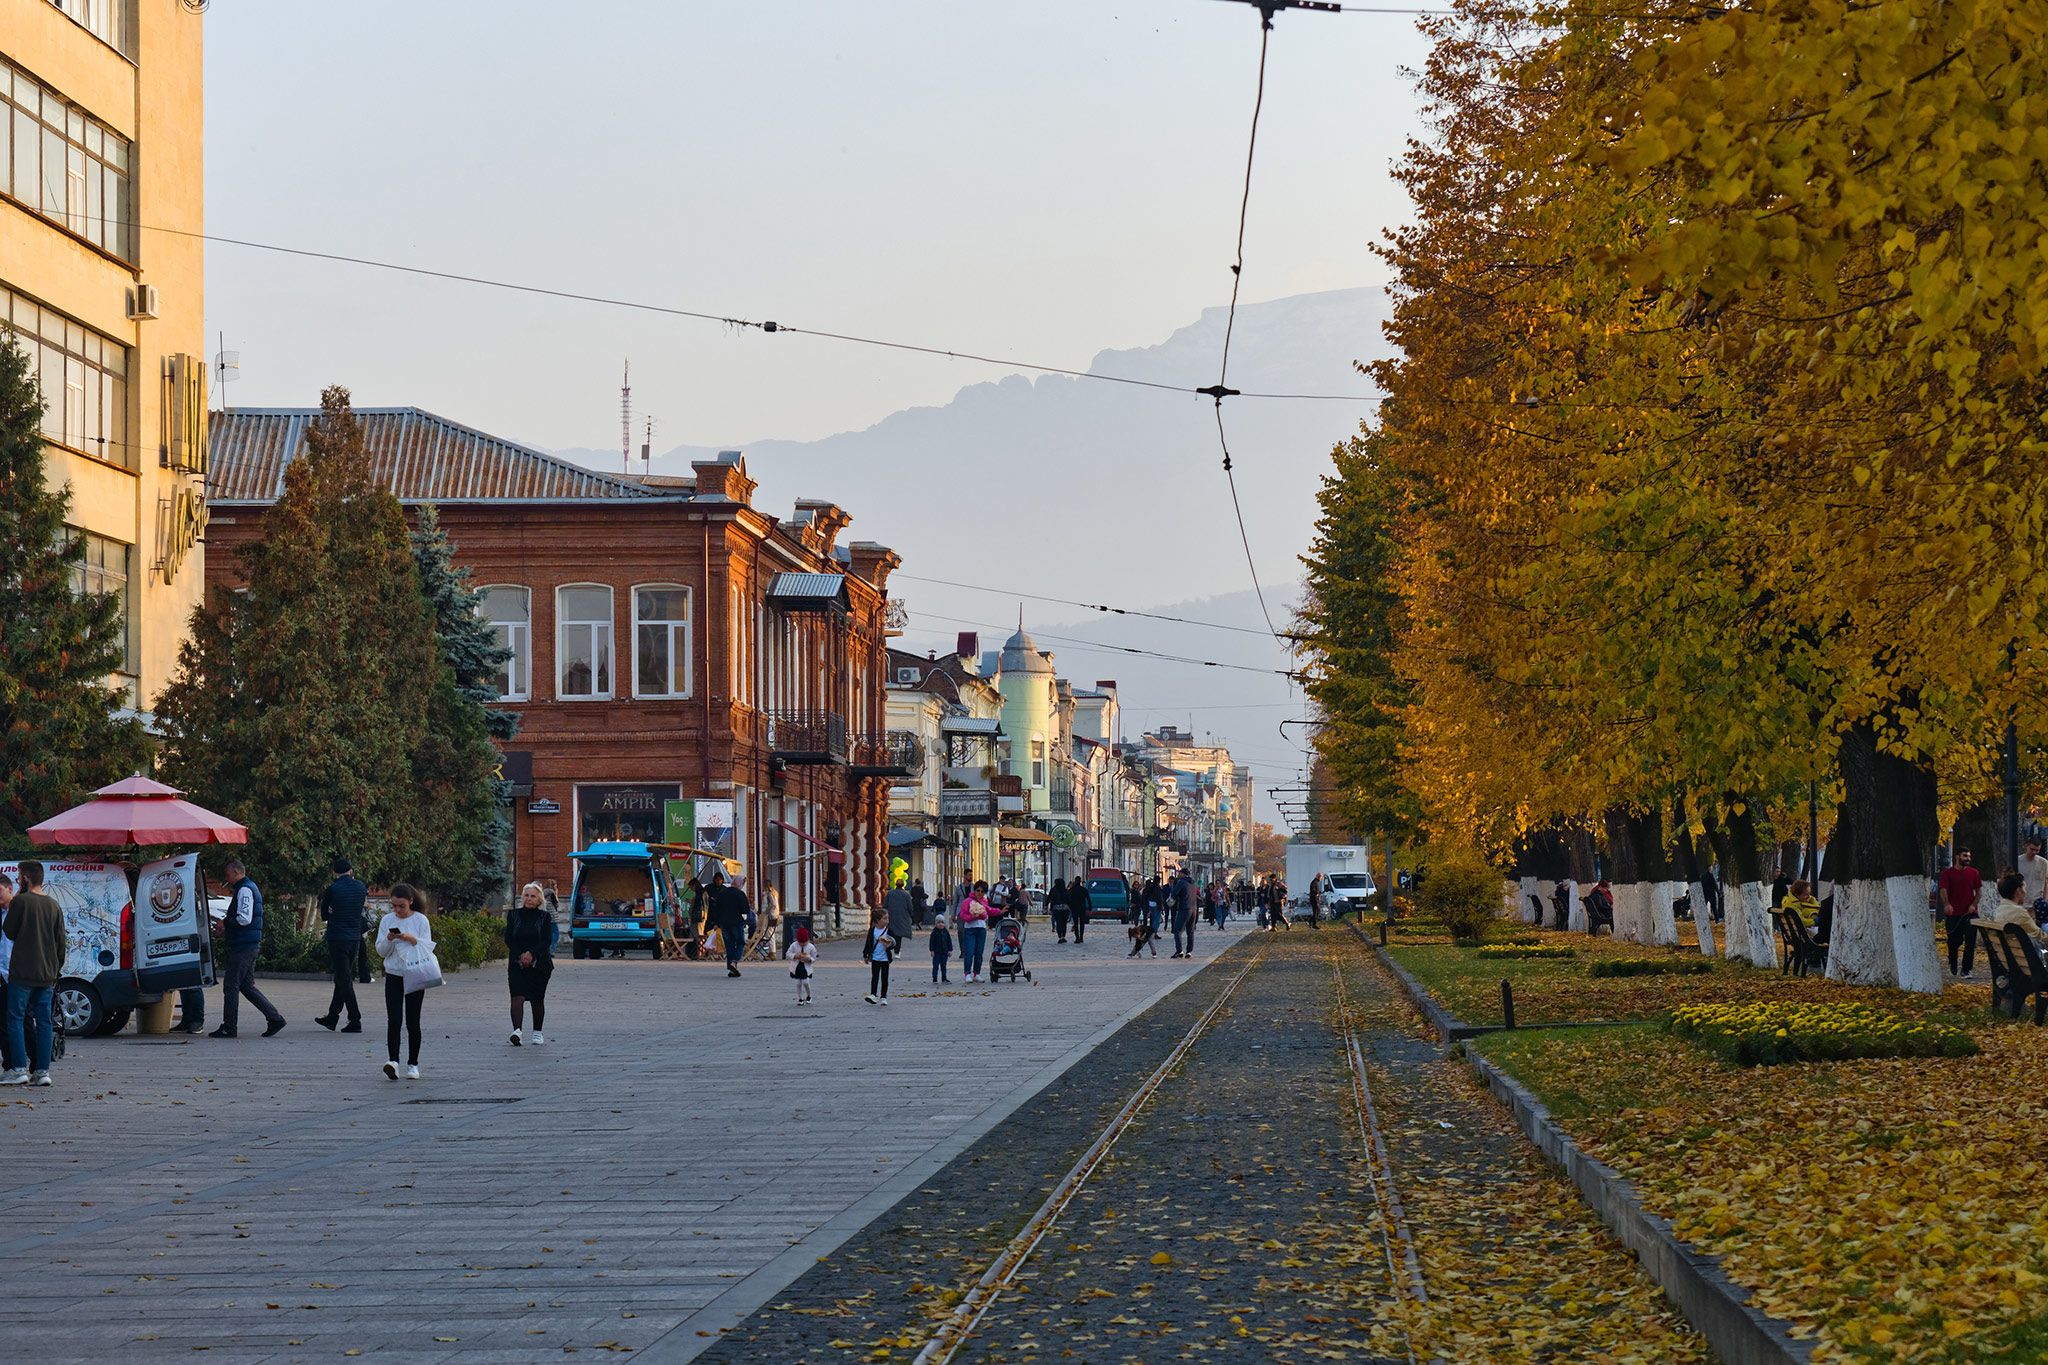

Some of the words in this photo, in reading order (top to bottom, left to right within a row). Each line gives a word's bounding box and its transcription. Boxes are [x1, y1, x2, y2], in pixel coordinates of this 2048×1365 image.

[601, 797, 656, 809] AMPIR
[49, 862, 105, 875] кофейня
[169, 873, 181, 885] CITY
